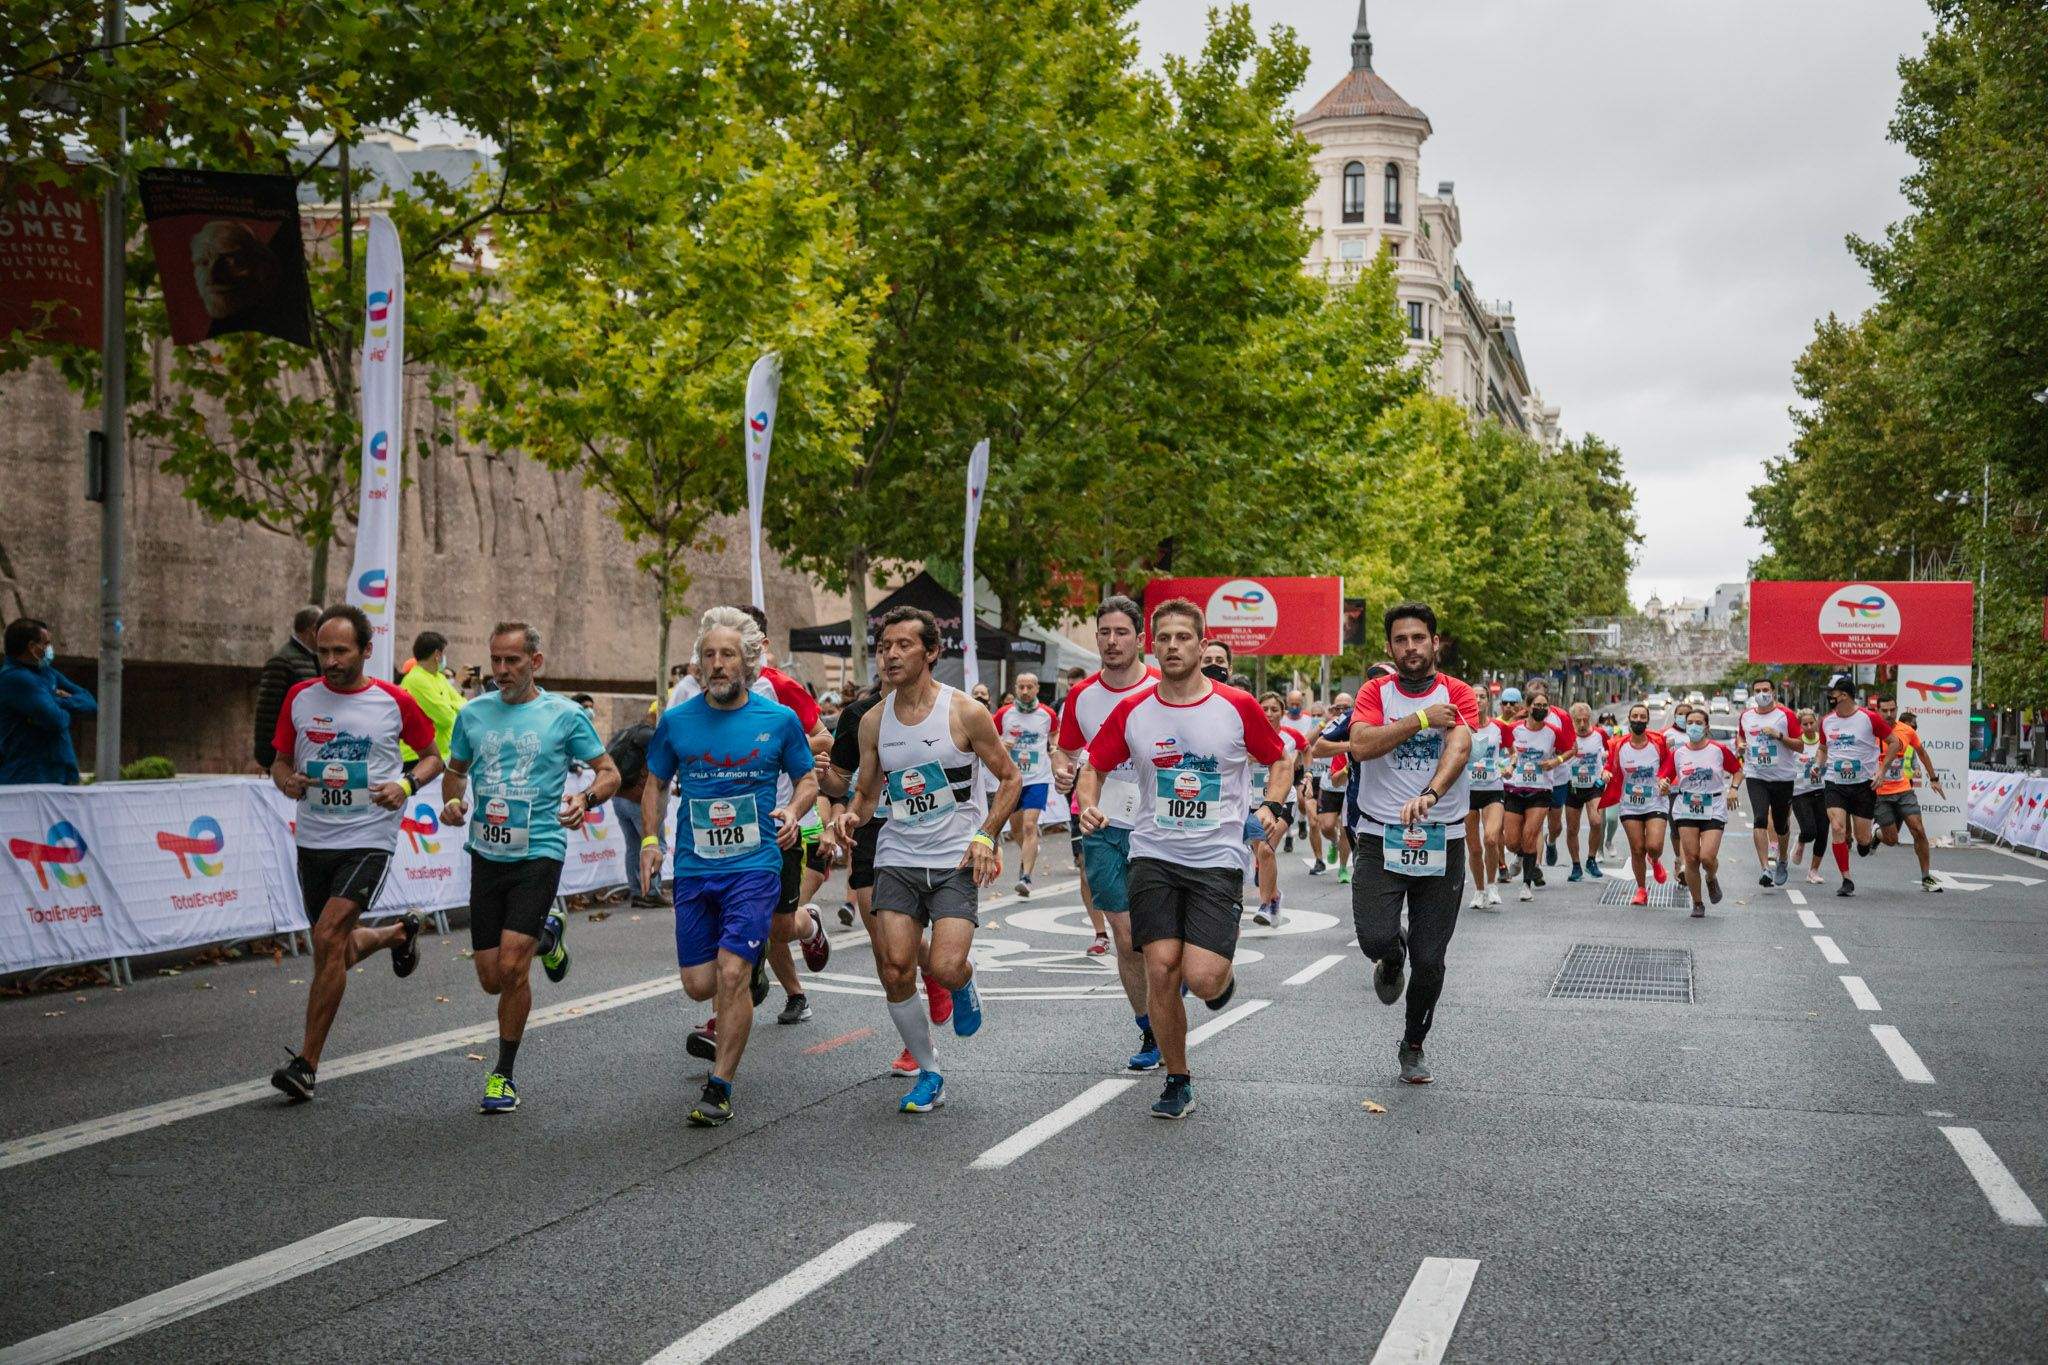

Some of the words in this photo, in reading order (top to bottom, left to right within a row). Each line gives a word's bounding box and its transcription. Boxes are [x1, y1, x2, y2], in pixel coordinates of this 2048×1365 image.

[0, 214, 88, 242] ÓMEZ
[3, 256, 81, 272] ULTURAL
[13, 270, 35, 280] LA
[45, 271, 94, 287] VILLA
[1838, 622, 1885, 630] TotalEnergies
[1905, 706, 1963, 716] TotalEnergies
[322, 789, 353, 806] 303
[906, 793, 938, 816] 262
[1168, 800, 1208, 819] 1029
[483, 824, 512, 845] 395
[707, 826, 745, 847] 1128
[1401, 849, 1429, 866] 579
[170, 888, 239, 912] TotalEnergies
[26, 902, 103, 924] ToalEnergies
